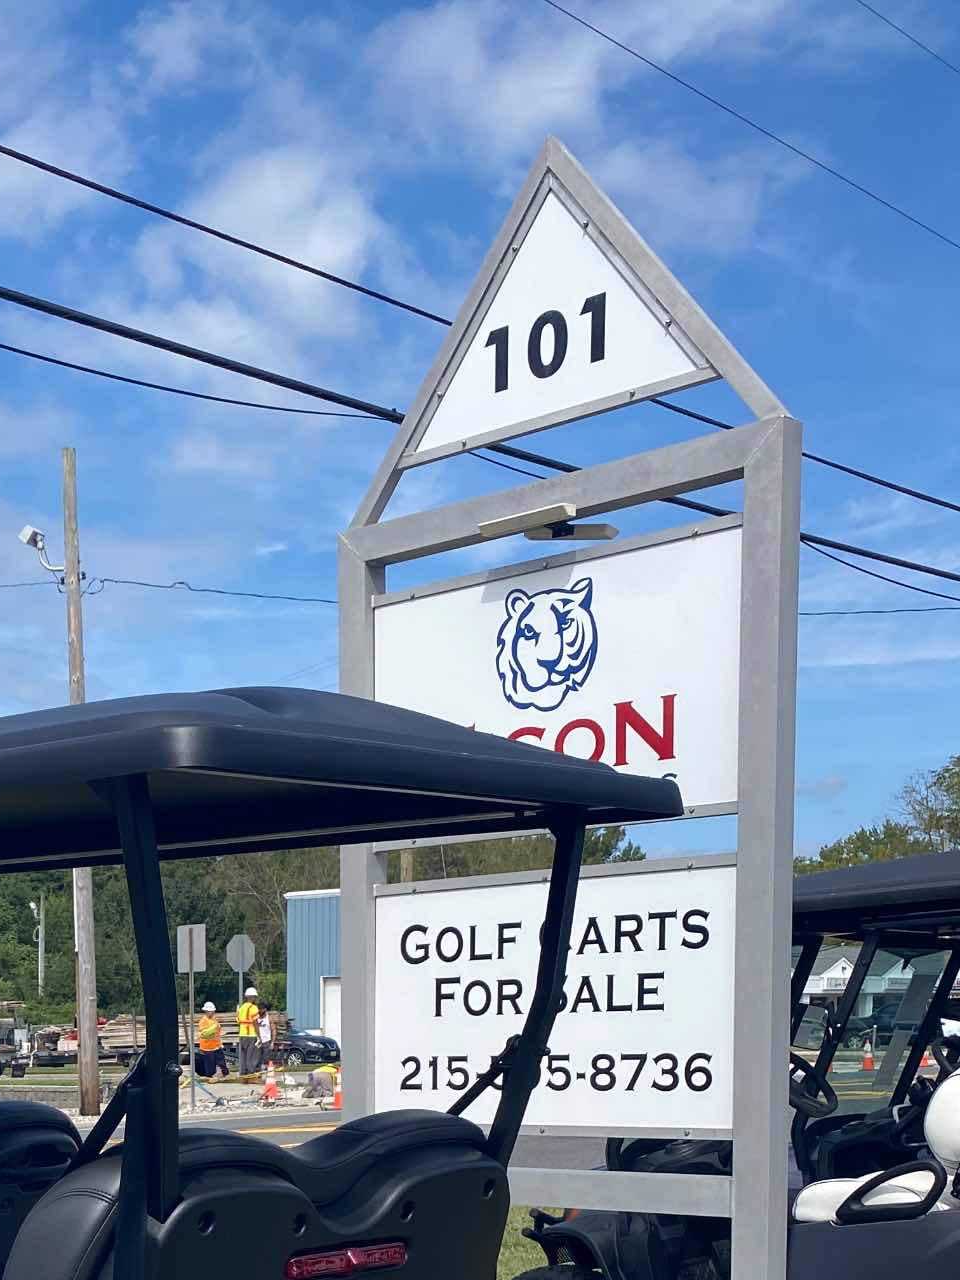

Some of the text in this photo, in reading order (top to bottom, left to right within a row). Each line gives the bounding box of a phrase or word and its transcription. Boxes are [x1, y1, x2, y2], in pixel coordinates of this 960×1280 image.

[484, 291, 606, 393] 101
[468, 693, 678, 768] ON
[400, 908, 711, 965] GOLF ARTS
[433, 971, 665, 1017] FOR ALE
[400, 1052, 713, 1092] 215-5-8736
